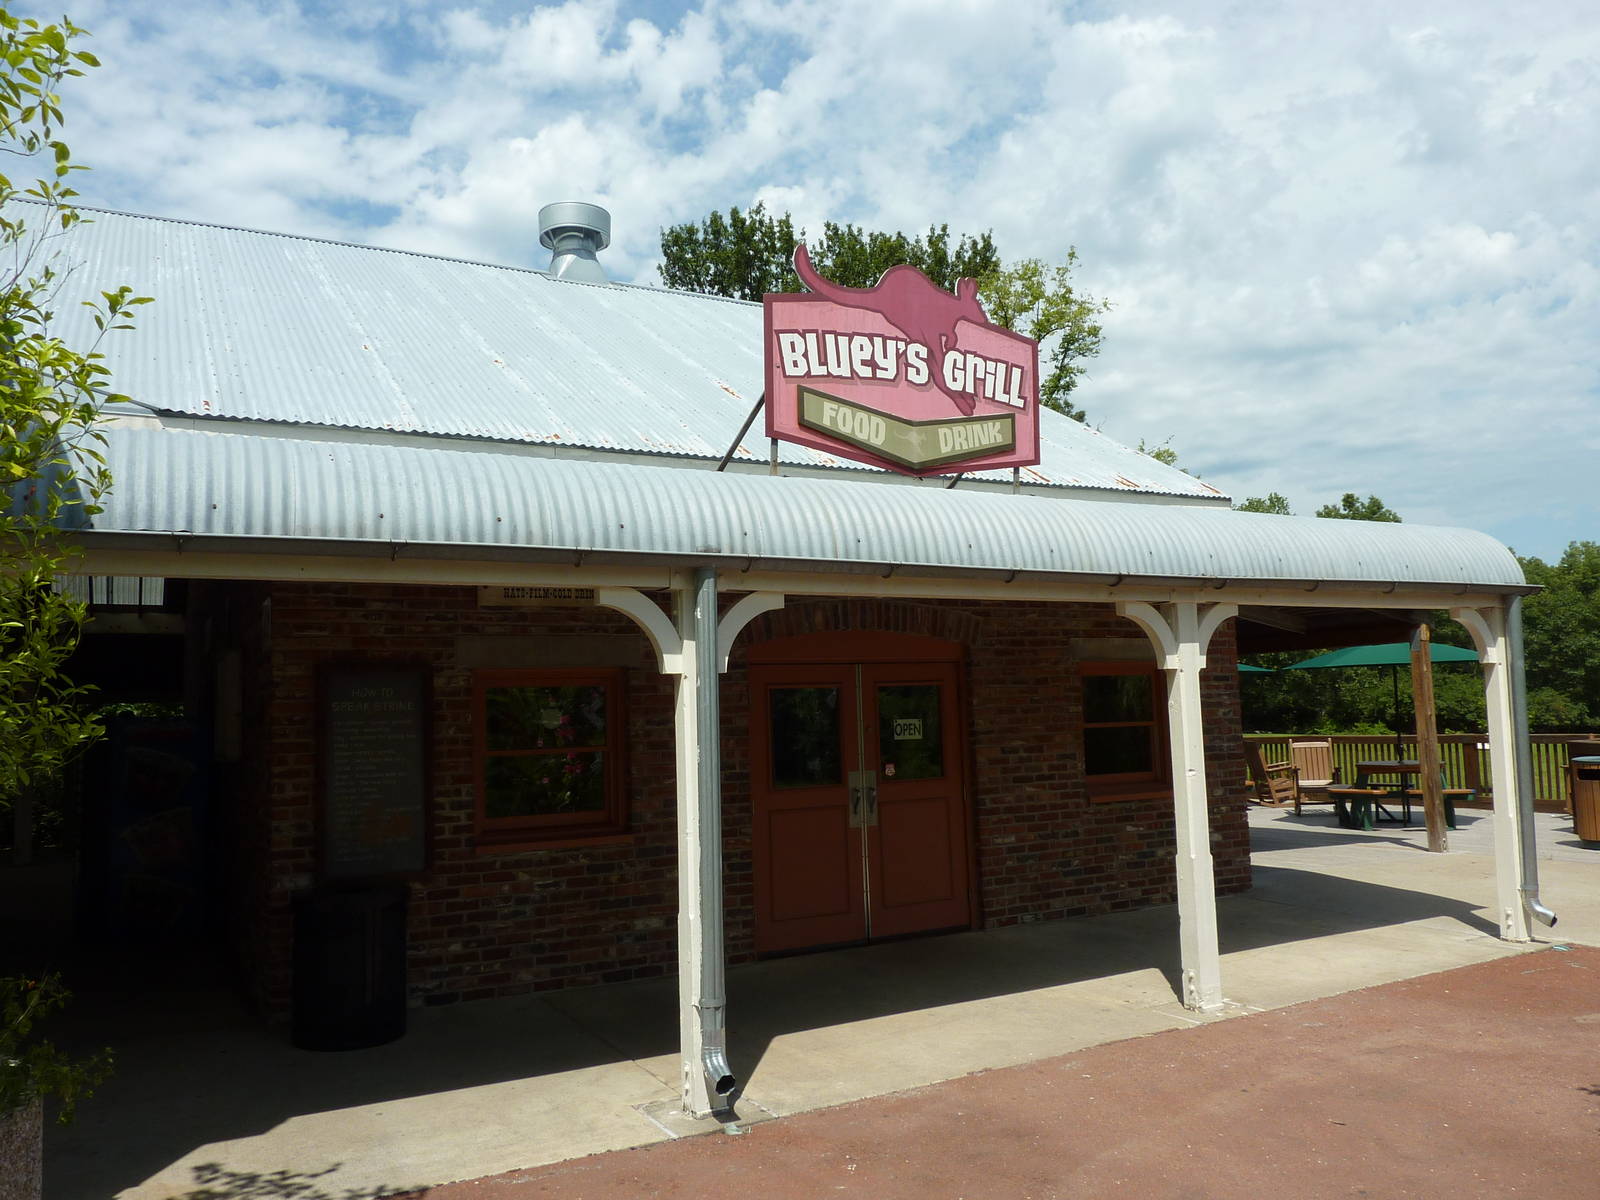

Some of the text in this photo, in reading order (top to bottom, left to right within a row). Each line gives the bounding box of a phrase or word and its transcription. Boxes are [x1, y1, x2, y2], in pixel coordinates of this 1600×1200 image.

[822, 401, 1003, 454] FOOD DRINK
[895, 723, 921, 736] OPEN
